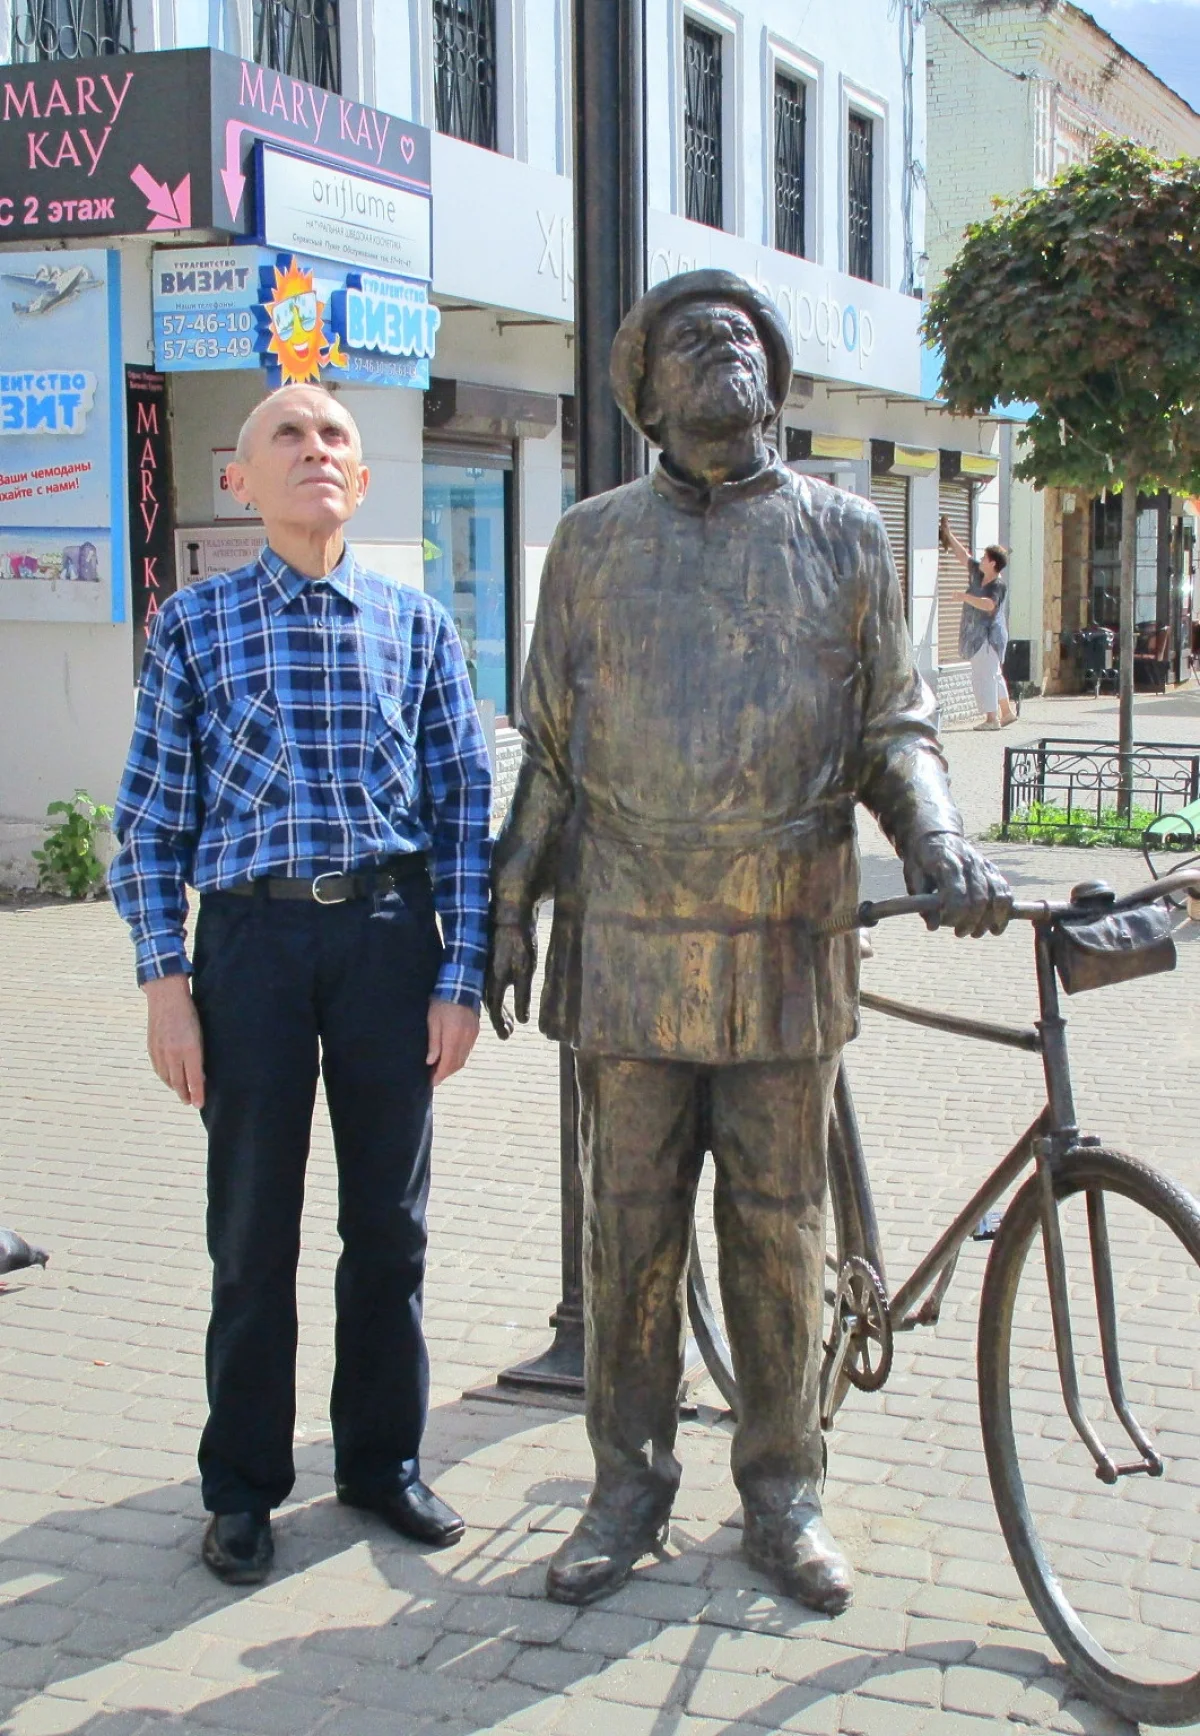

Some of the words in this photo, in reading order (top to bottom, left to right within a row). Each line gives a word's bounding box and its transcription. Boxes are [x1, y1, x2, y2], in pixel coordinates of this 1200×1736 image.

[3, 72, 134, 124] MARY
[239, 61, 329, 144] MARY
[338, 98, 390, 165] KAY
[27, 126, 112, 177] KAY
[23, 196, 39, 225] 2
[47, 198, 115, 223] этаж
[312, 176, 396, 223] oriflame
[174, 259, 236, 269] ТУРАГЕНТСТВО
[161, 267, 250, 294] ВИЗИТ
[163, 312, 252, 335] 57-46-10
[347, 294, 437, 354] ВИЗИТ
[164, 337, 252, 360] 57-63-49
[31, 462, 91, 478] чемоданы
[137, 402, 160, 544] MARY
[36, 486, 43, 495] с
[46, 478, 80, 494] нами!
